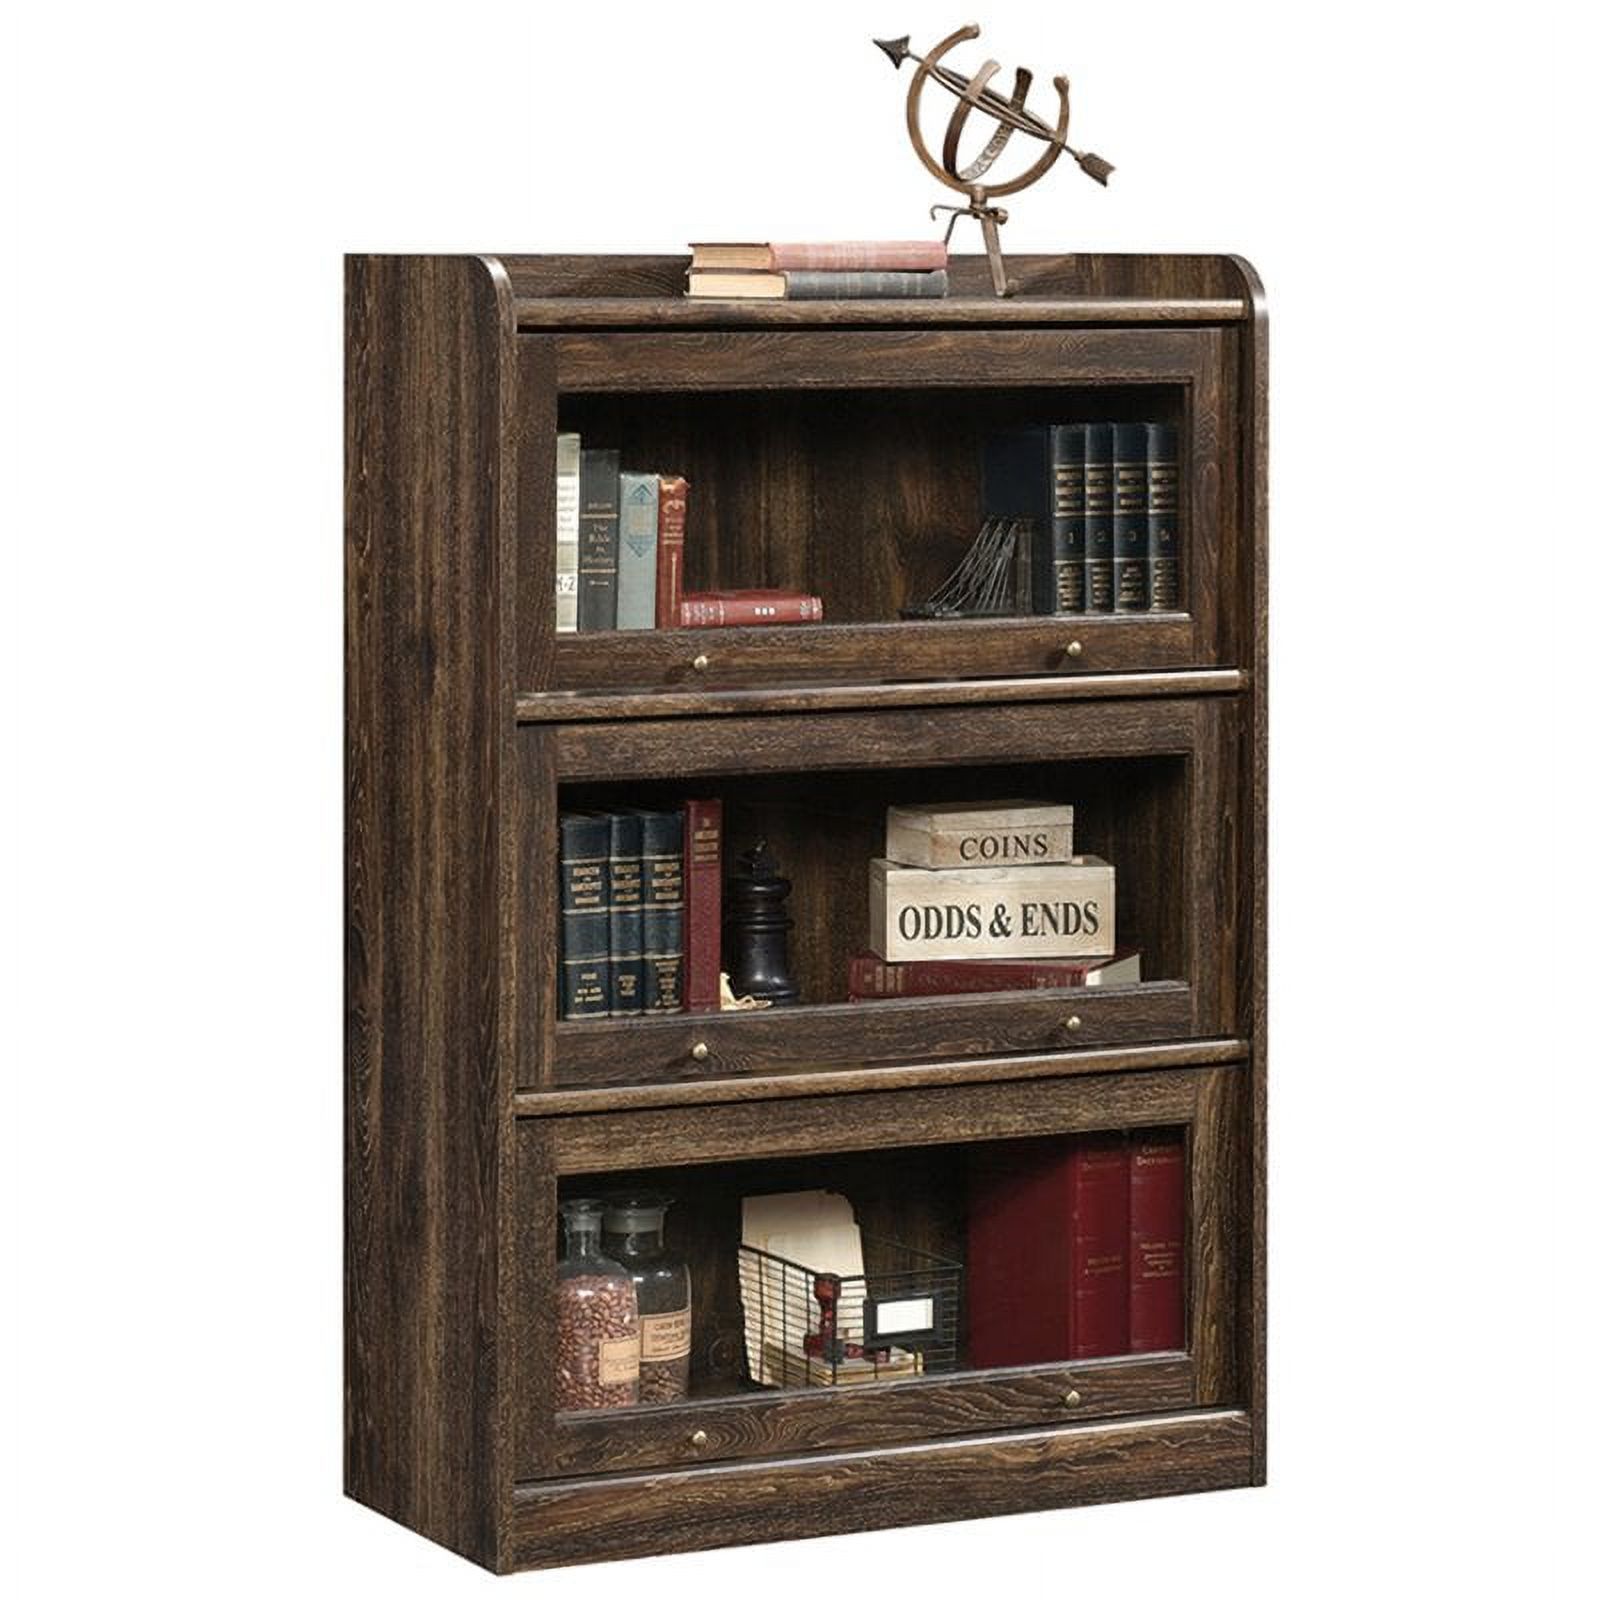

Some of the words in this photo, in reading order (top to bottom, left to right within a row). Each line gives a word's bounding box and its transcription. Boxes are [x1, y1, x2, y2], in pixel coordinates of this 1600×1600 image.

[1067, 531, 1074, 545] 1
[959, 834, 1048, 860] COINS
[899, 904, 982, 940] ODDS
[988, 903, 1012, 938] &
[1020, 901, 1099, 937] ENDS
